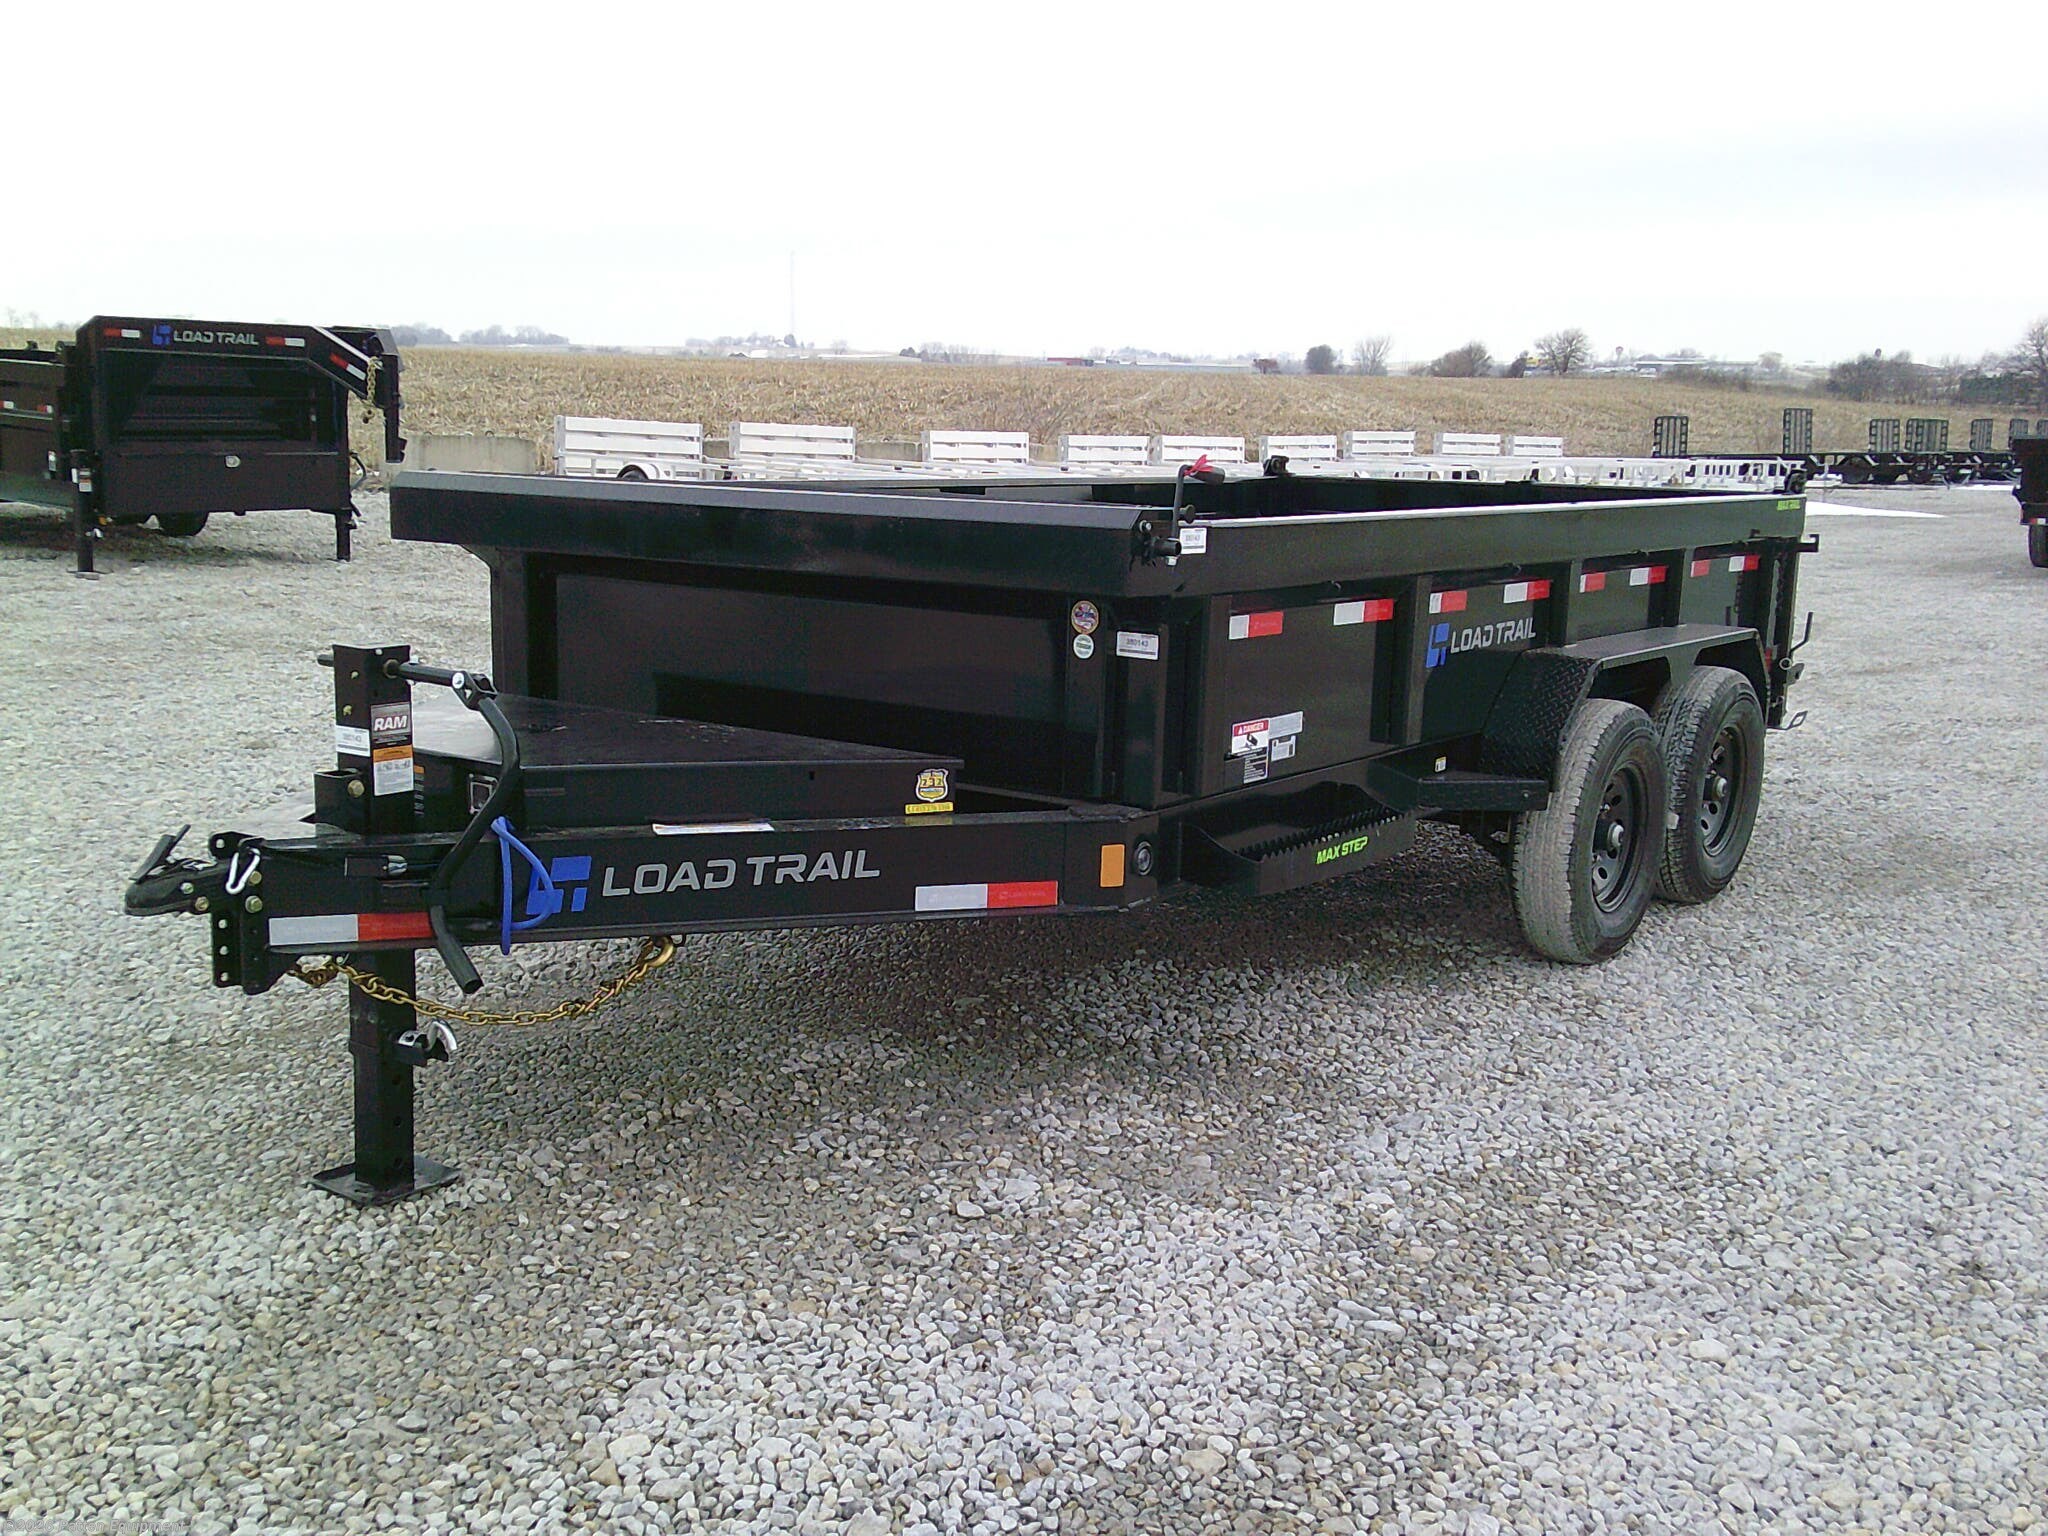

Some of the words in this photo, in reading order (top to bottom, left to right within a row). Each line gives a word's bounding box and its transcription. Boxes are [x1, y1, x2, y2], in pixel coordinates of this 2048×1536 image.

[173, 329, 213, 343] LOAD
[216, 331, 259, 346] TRAIL
[1450, 624, 1493, 654] LOAD
[1496, 616, 1536, 645] TRAIL
[373, 715, 408, 732] RAM
[1315, 845, 1341, 865] MAX
[1341, 836, 1369, 858] STEP
[602, 858, 736, 897] LOAD
[746, 849, 880, 886] TRAIL
